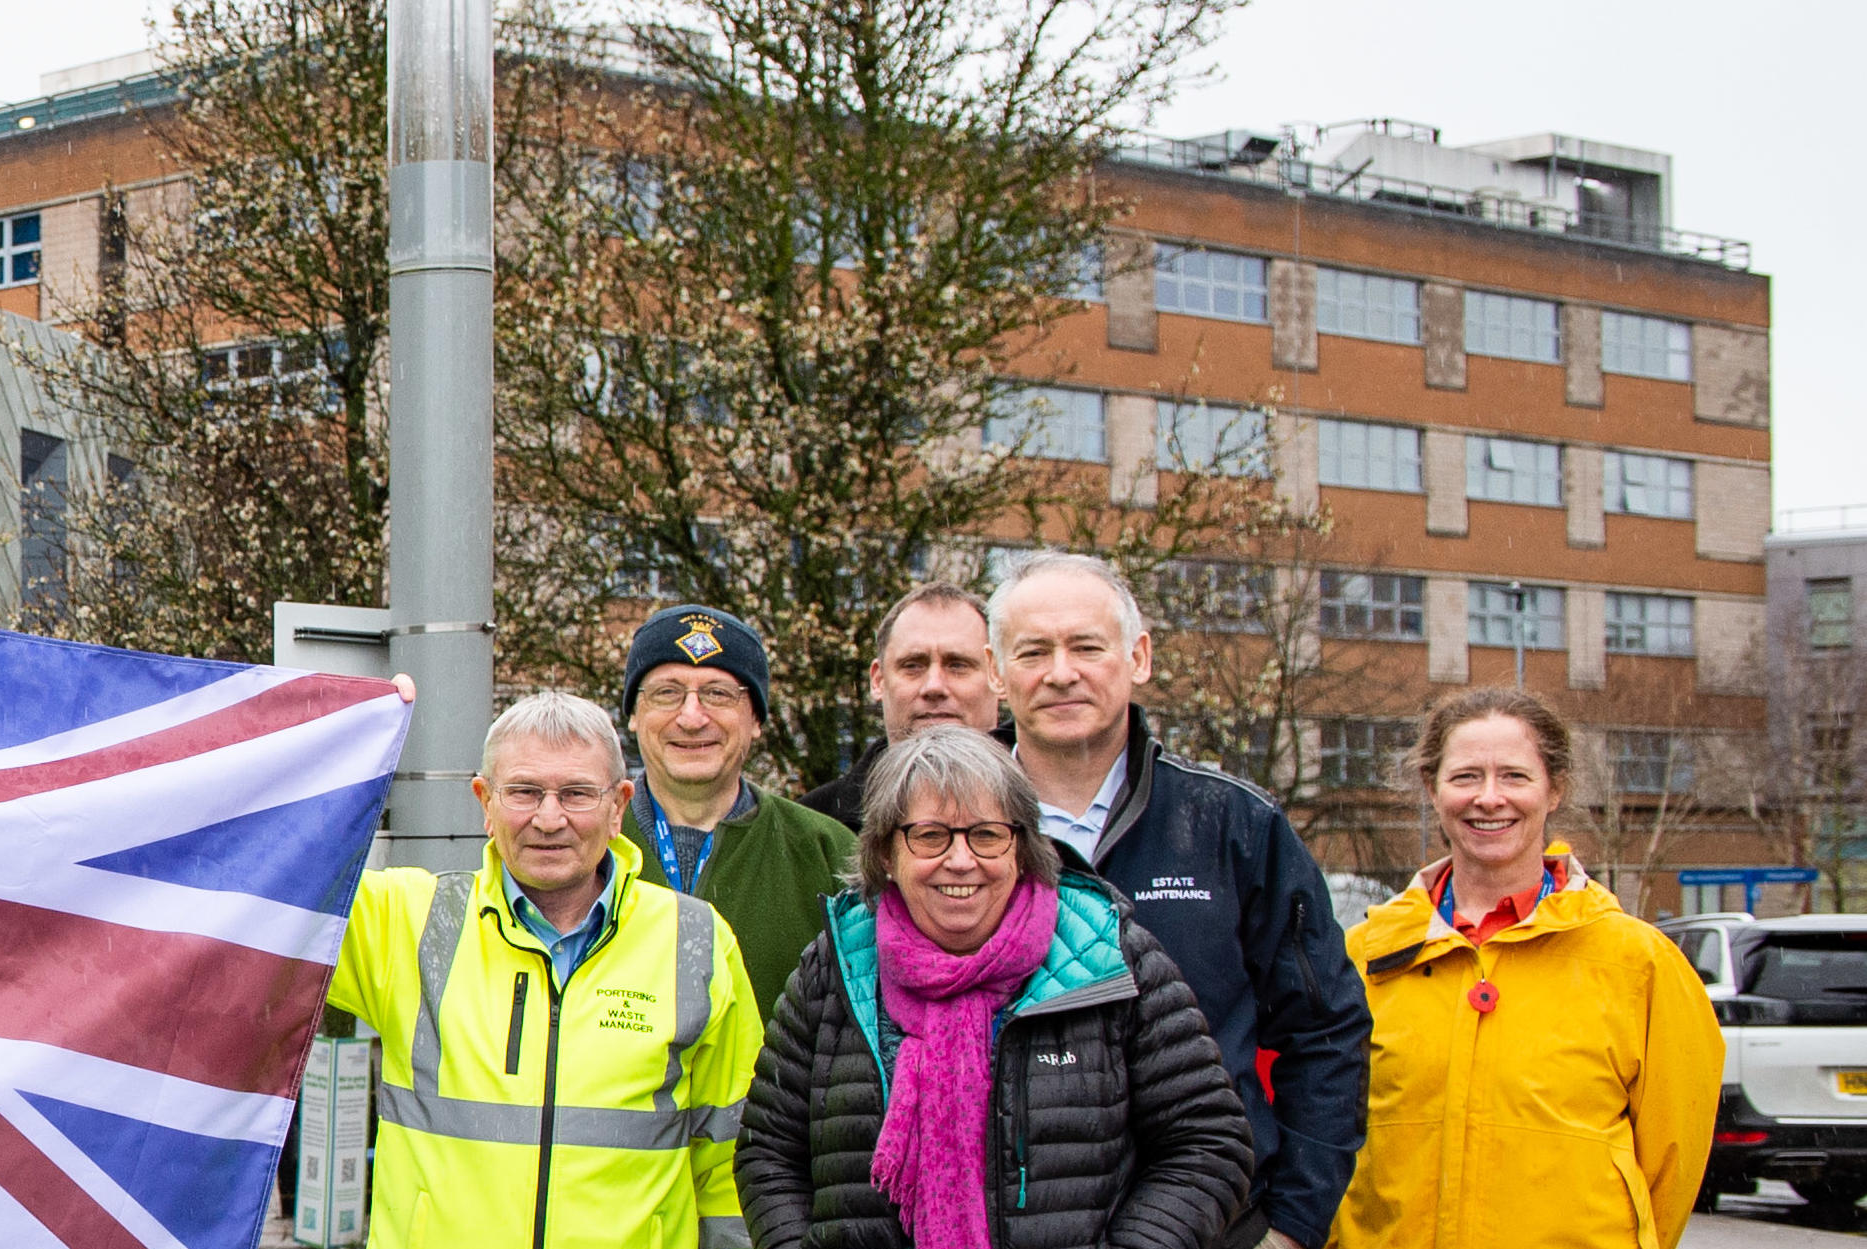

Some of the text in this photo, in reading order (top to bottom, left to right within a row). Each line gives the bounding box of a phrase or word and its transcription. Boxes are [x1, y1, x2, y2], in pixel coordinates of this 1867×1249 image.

[1152, 877, 1195, 888] ESTATE
[1135, 889, 1212, 900] MAINTENANCE
[596, 989, 656, 1003] PORTERING
[623, 1000, 630, 1008] &
[608, 1009, 645, 1021] WASTE
[599, 1020, 653, 1032] MANAGER
